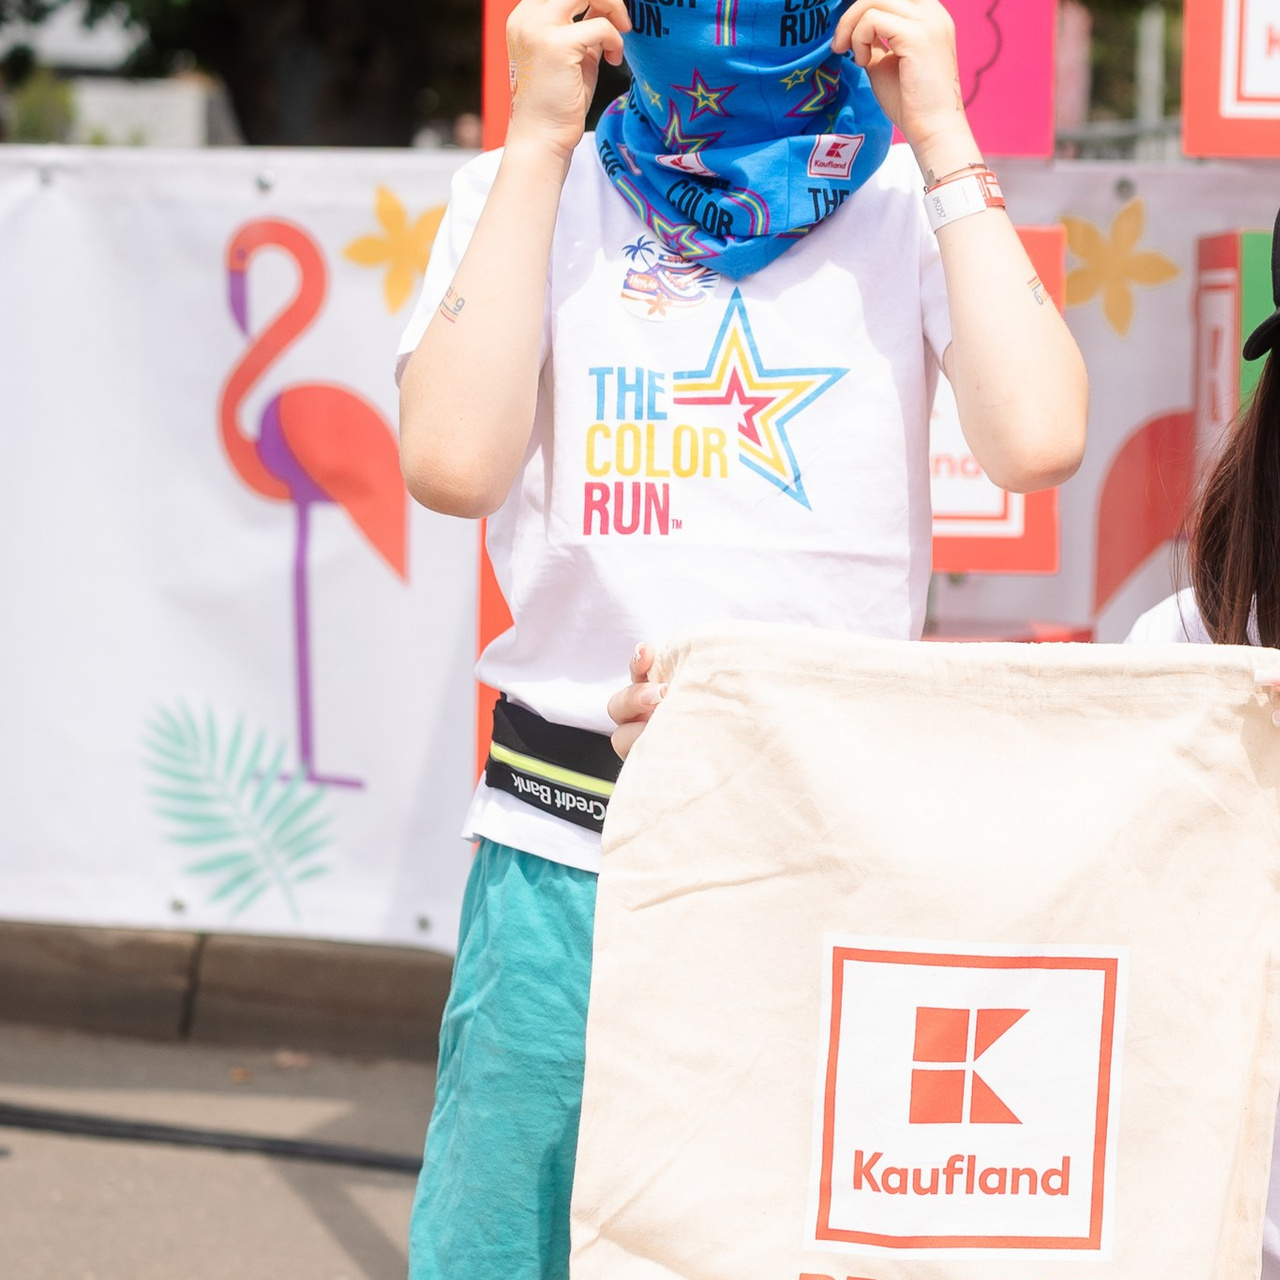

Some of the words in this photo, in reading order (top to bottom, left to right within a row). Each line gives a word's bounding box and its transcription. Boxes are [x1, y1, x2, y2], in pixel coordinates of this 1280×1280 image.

[780, 5, 829, 47] RUN
[814, 160, 847, 169] Kaufland
[589, 367, 667, 420] THE
[586, 423, 728, 478] COLOR
[583, 482, 669, 535] RUN
[511, 773, 551, 805] Bank
[853, 1150, 1070, 1195] Kaufland
